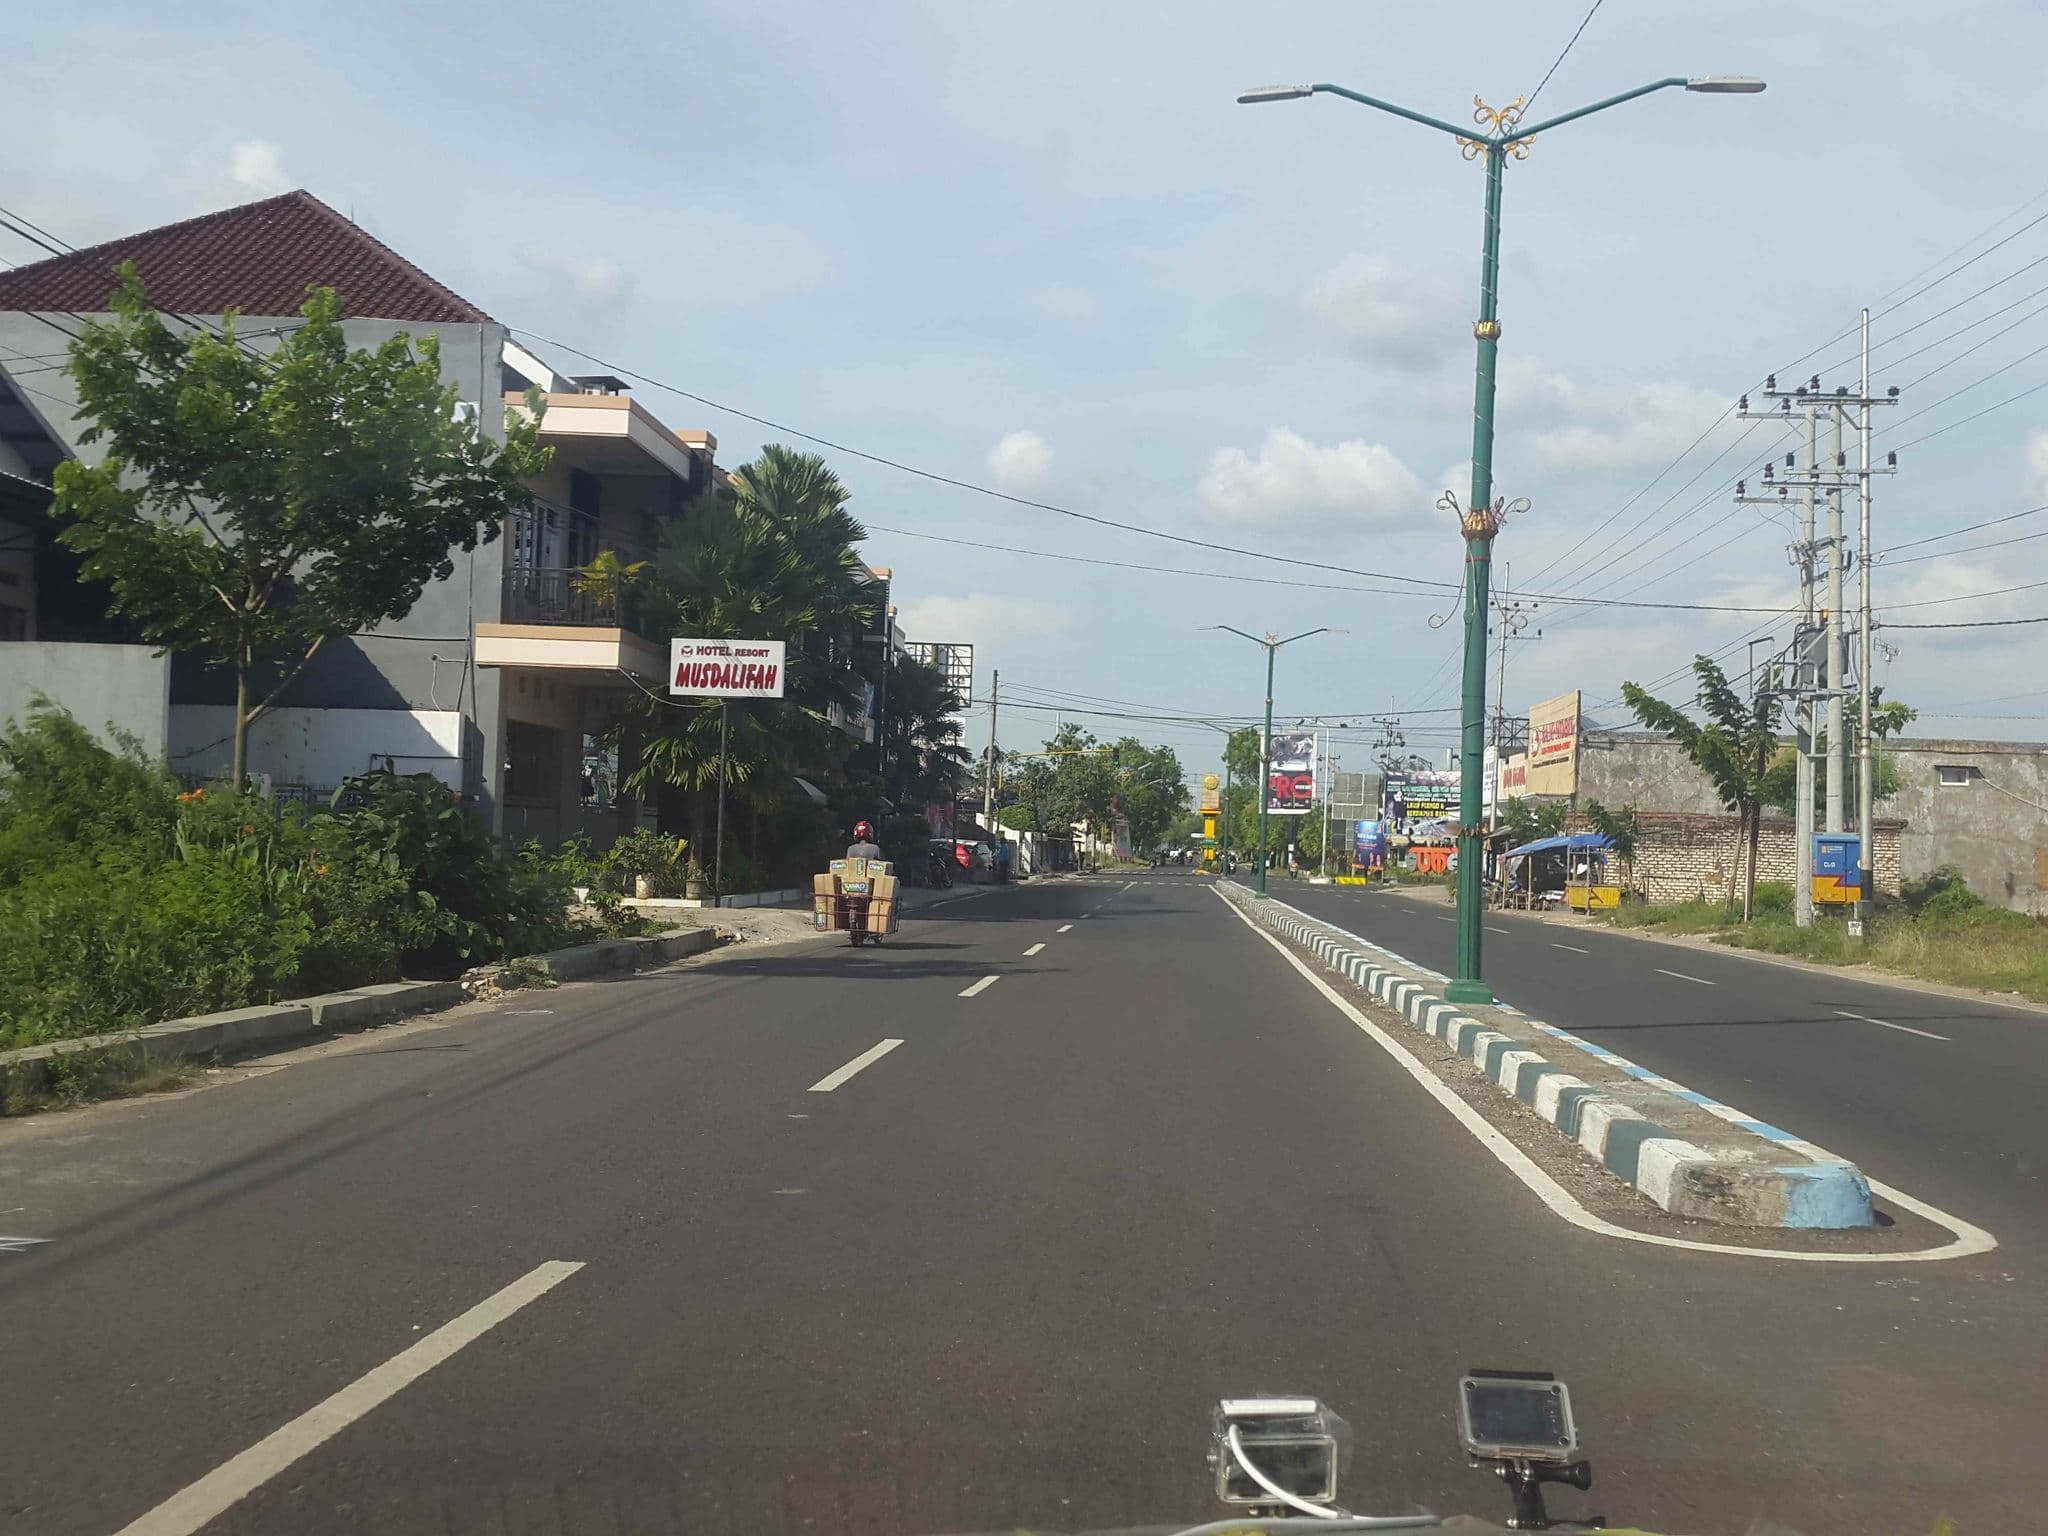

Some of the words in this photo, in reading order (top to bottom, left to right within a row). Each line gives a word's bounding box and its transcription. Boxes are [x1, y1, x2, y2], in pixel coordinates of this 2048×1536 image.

[696, 646, 732, 656] HOTEL
[734, 648, 770, 657] RESORT
[675, 662, 777, 690] MUSDALIFAH
